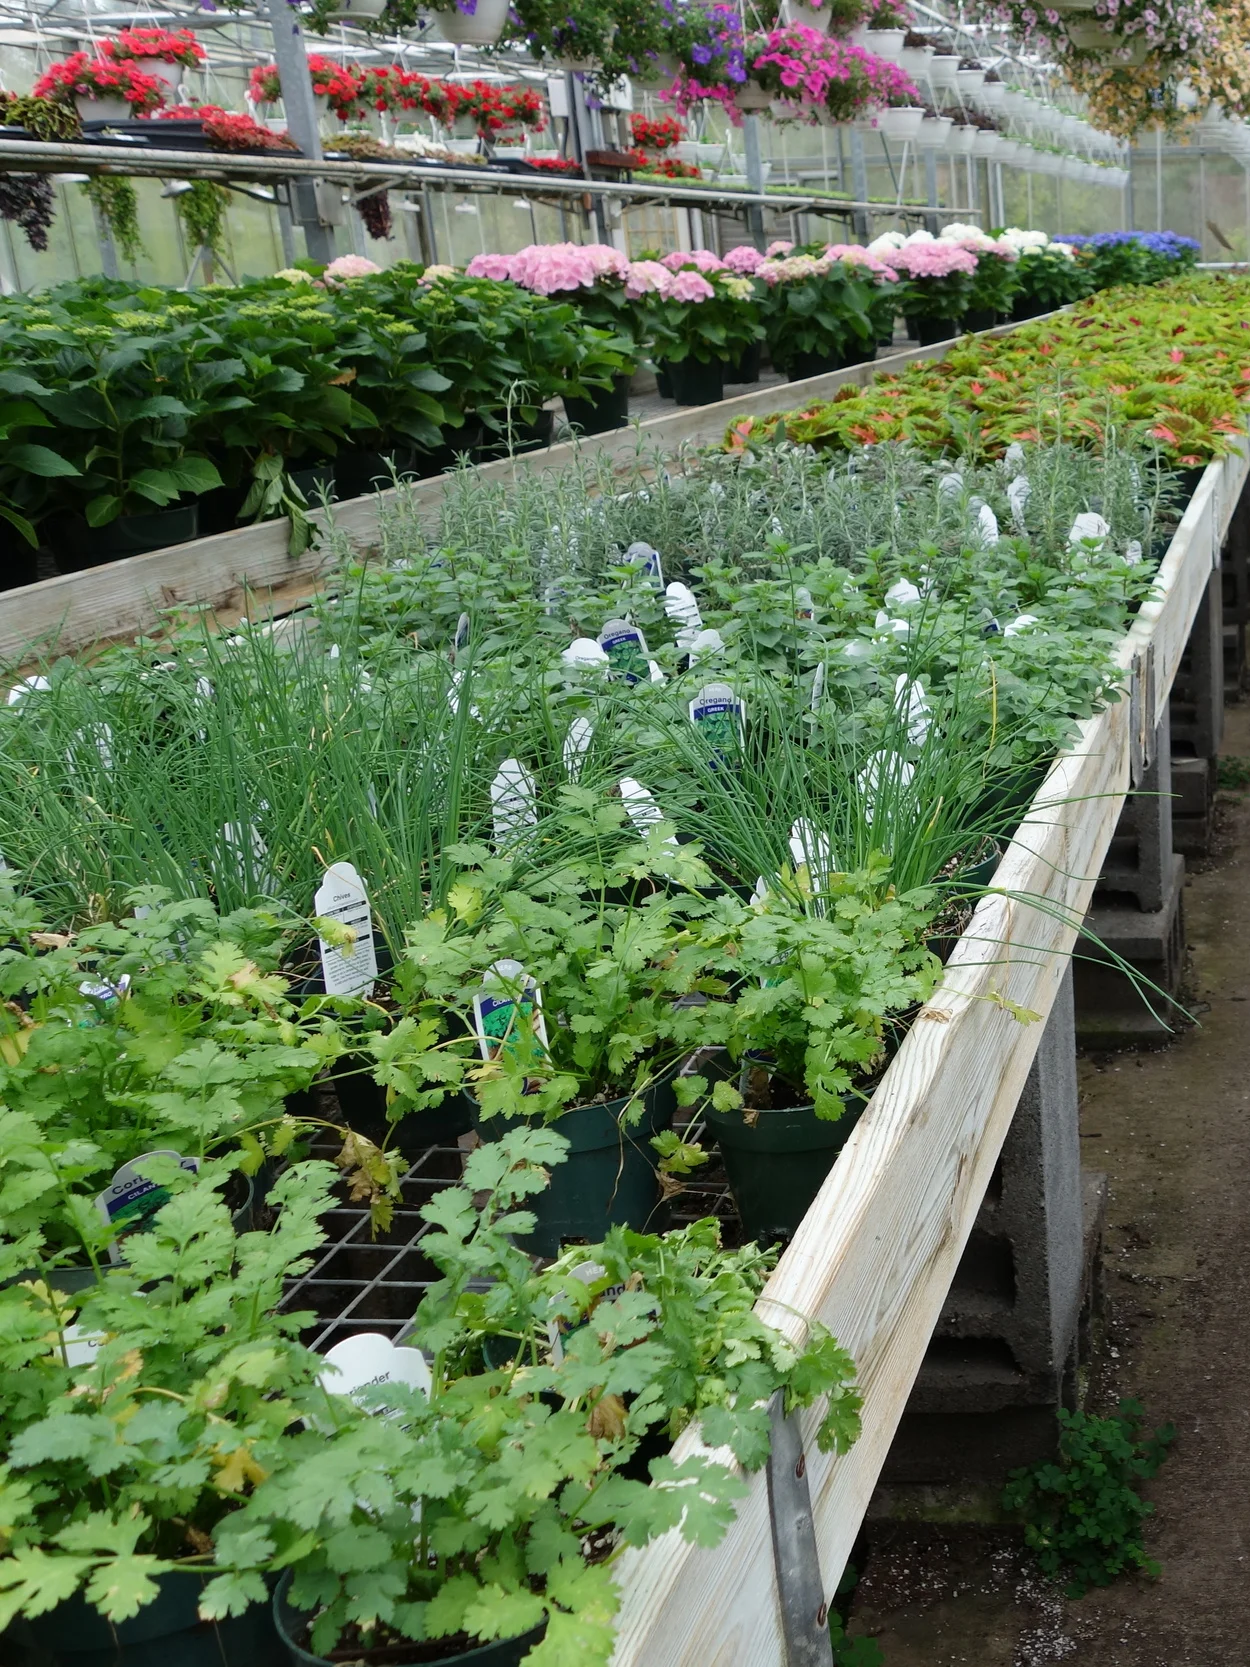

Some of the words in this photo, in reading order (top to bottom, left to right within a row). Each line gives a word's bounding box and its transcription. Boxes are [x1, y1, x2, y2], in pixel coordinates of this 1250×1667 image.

[603, 628, 631, 640] Oregano
[699, 697, 732, 706] Oregano
[332, 892, 352, 902] Chives
[127, 1183, 157, 1200] CILAN
[584, 1265, 606, 1276] HER
